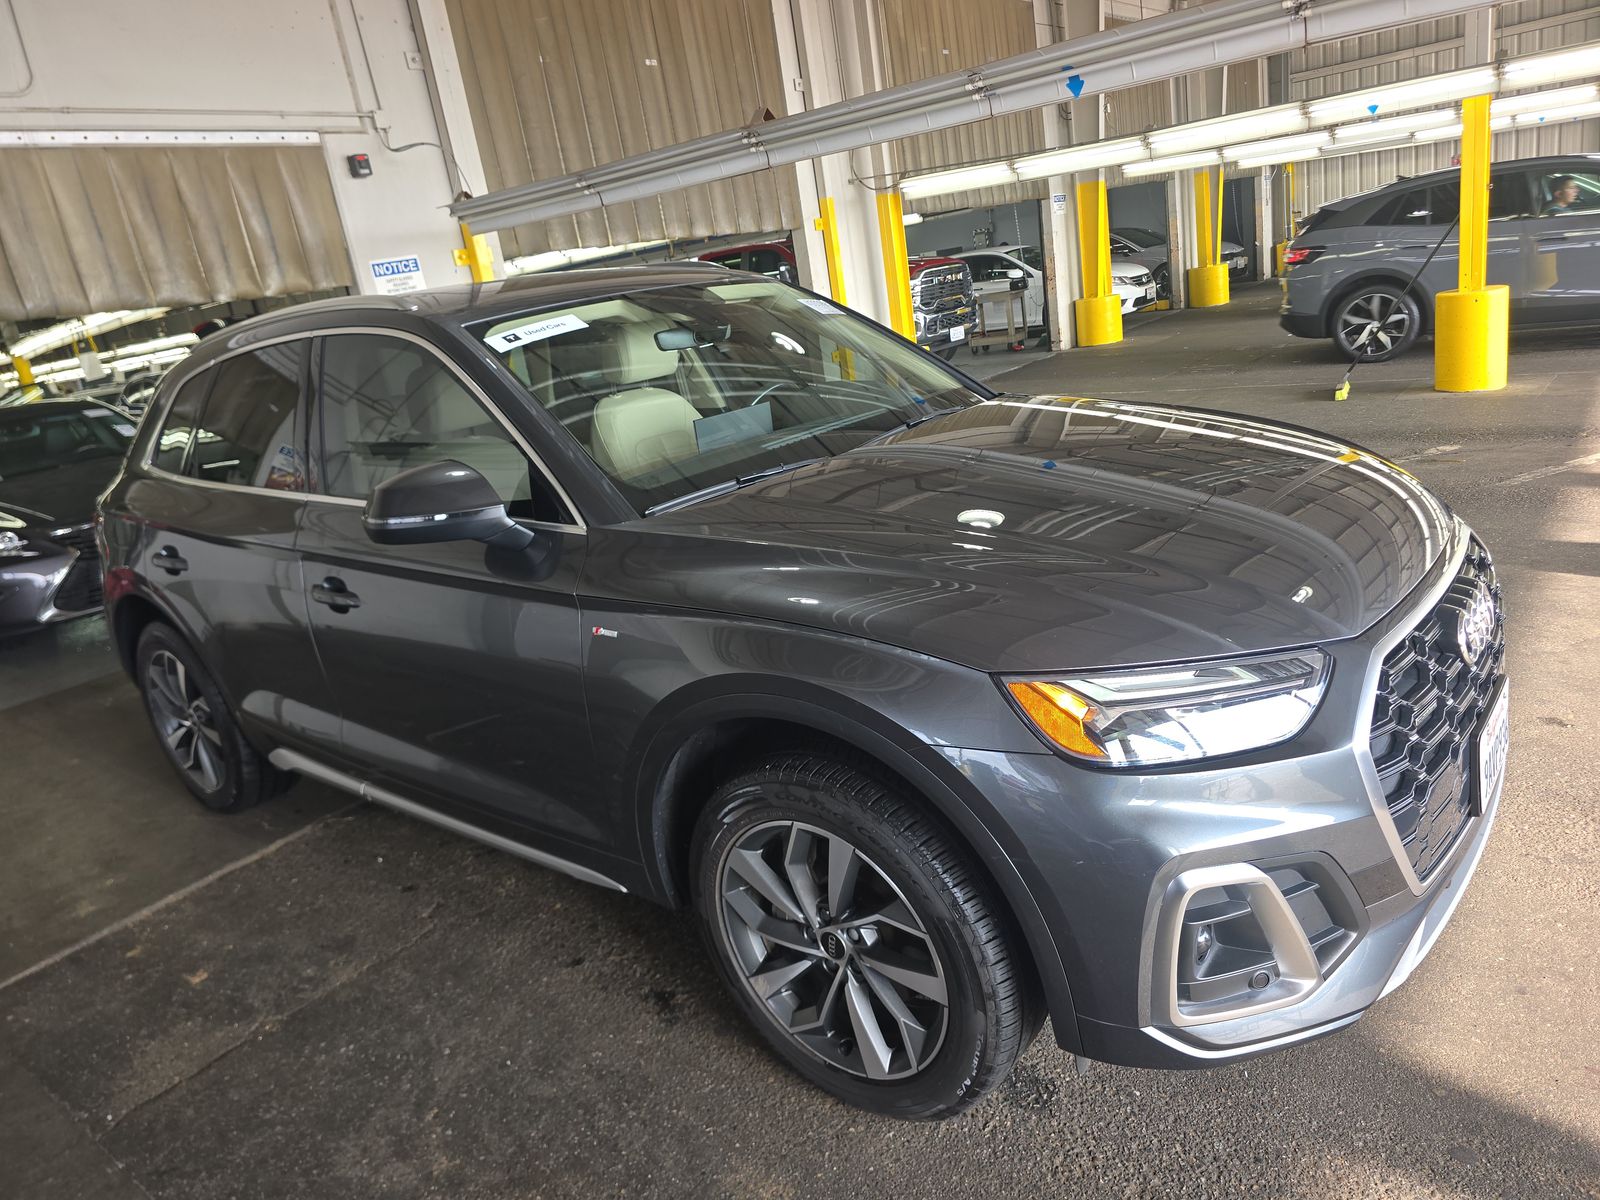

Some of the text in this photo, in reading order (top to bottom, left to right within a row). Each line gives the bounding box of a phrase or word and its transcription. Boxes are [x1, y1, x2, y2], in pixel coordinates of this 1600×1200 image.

[374, 260, 417, 276] NOTICE
[523, 327, 547, 336] Used
[546, 323, 567, 331] Cars
